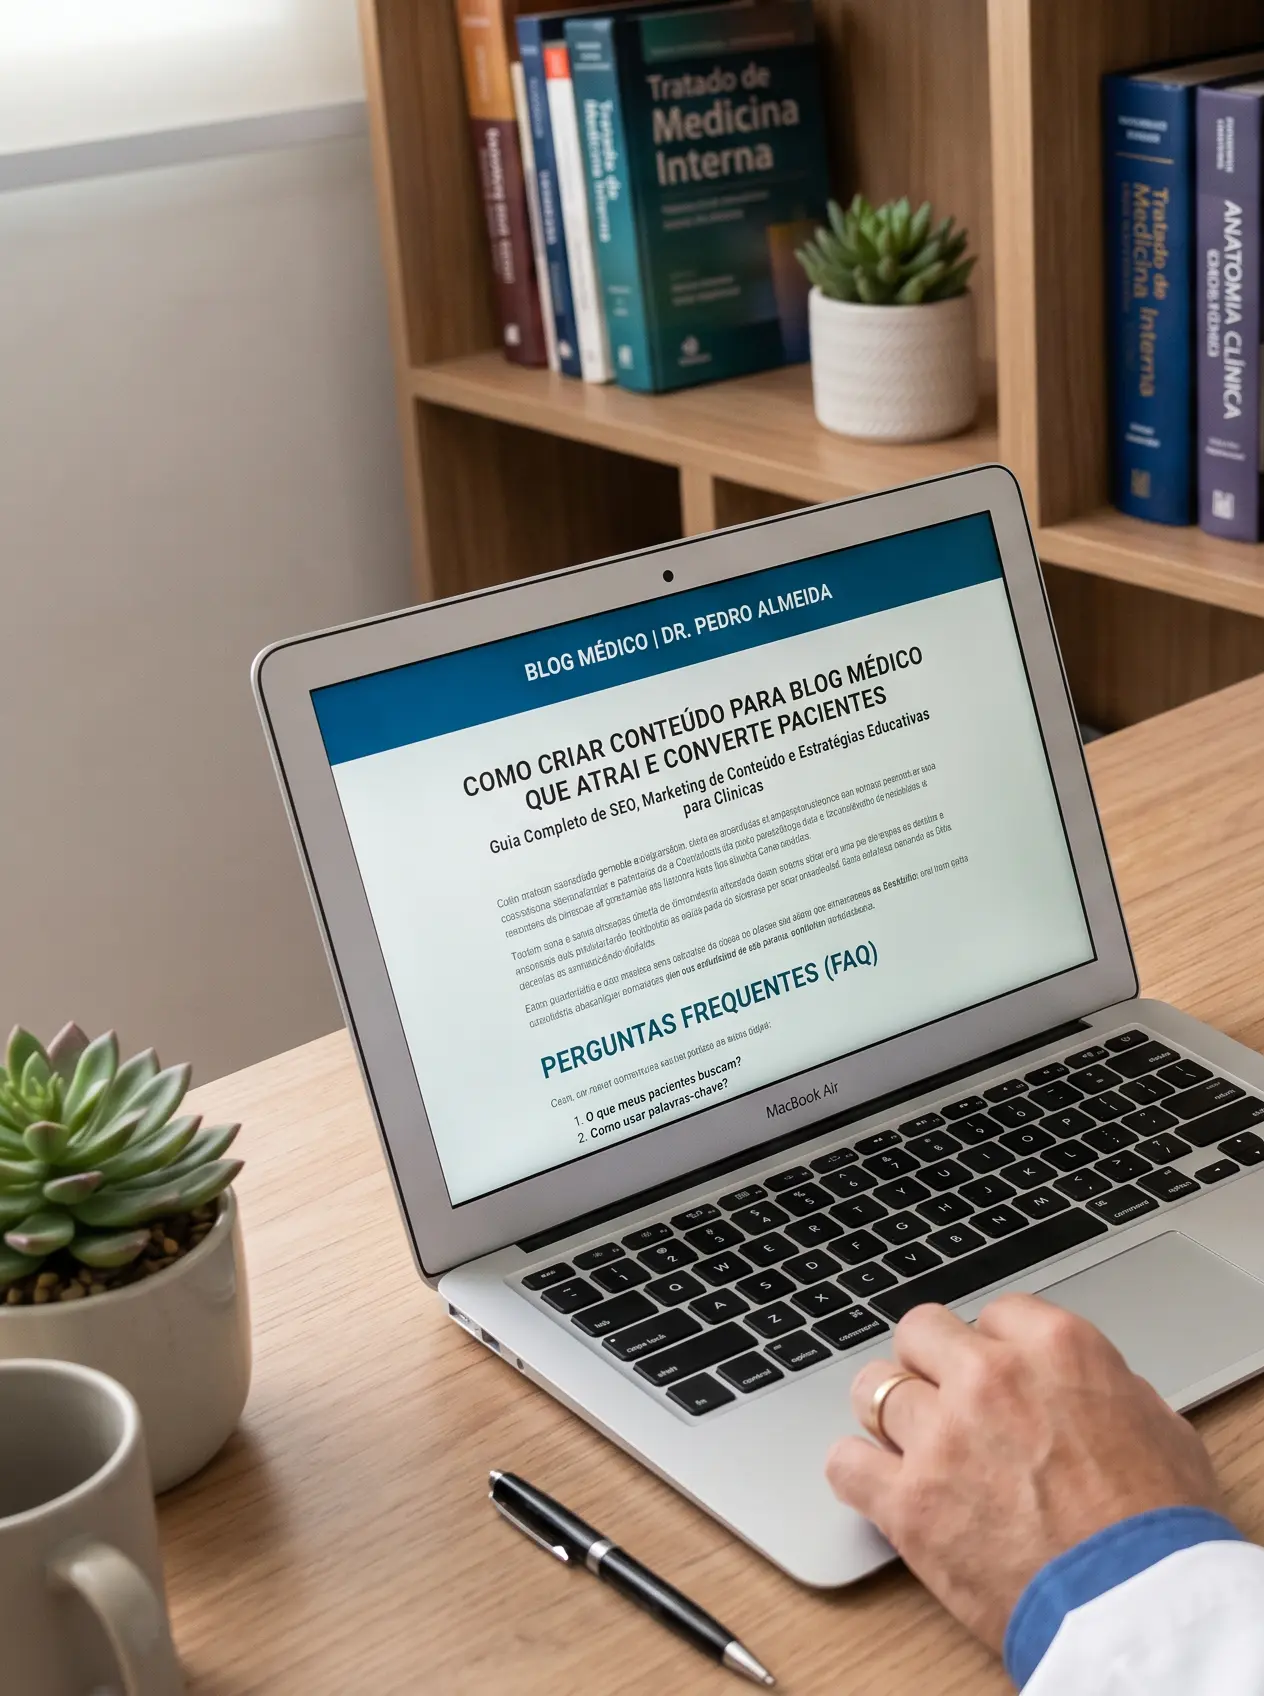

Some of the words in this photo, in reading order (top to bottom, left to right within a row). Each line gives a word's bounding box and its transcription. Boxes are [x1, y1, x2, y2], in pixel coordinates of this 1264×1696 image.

[648, 66, 737, 101] Tratado
[741, 60, 770, 89] de
[651, 96, 799, 144] Medicina
[655, 141, 774, 186] Interna
[1223, 200, 1244, 327] ANATOMIA
[1222, 331, 1244, 421] CLÍNICA
[524, 653, 574, 681] BLOG
[577, 633, 648, 667] MÉDICO
[661, 622, 691, 644] DR.
[694, 605, 752, 635] PEDRO
[758, 583, 833, 618] ALMEIDA
[463, 760, 532, 796] COMO
[538, 739, 606, 774] CRIAR
[610, 704, 725, 753] CONTEÚDO
[729, 686, 787, 719] PARA
[789, 669, 843, 701] BLOG
[846, 646, 922, 684] MÉDICO
[525, 780, 571, 811] QUE
[577, 759, 640, 796] ATRAI
[644, 753, 660, 775] E
[664, 718, 775, 768] CONVERTE
[777, 686, 887, 735] PACIENTES
[490, 835, 521, 854] Guia
[524, 816, 587, 843] Completo
[591, 808, 607, 823] de
[609, 798, 640, 817] SEO,
[641, 779, 706, 807] Marketing
[709, 771, 725, 786] de
[727, 753, 785, 780] Conteúdo
[788, 752, 796, 762] e
[798, 730, 865, 759] Estratégias
[866, 710, 930, 737] Educativas
[683, 798, 712, 819] para
[714, 781, 764, 805] Clinicas
[540, 1013, 677, 1079] PERGUNTAS
[680, 962, 819, 1028] FREQUENTES
[824, 940, 878, 982] (FAQ)
[574, 1116, 584, 1126] 1.
[586, 1111, 594, 1122] O
[596, 1105, 616, 1120] que
[618, 1094, 646, 1111] meus
[648, 1075, 696, 1102] pacientes
[697, 1056, 741, 1081] buscam?
[766, 1088, 821, 1118] MacBook
[823, 1082, 838, 1097] Air
[577, 1132, 588, 1143] 2.
[590, 1121, 621, 1138] Como
[623, 1111, 645, 1126] usar
[648, 1078, 728, 1119] palavras-chave?
[1061, 1118, 1071, 1126] P
[1021, 1135, 1034, 1143] O
[937, 1169, 951, 1177] U
[1022, 1167, 1036, 1176] K
[895, 1187, 906, 1195] Y
[1033, 1197, 1049, 1206] M
[852, 1205, 863, 1213] T
[938, 1203, 953, 1212] H
[991, 1215, 1007, 1224] N
[808, 1224, 821, 1233] R
[895, 1222, 909, 1230] G
[763, 1244, 775, 1252] E
[851, 1241, 860, 1250] F
[904, 1253, 917, 1261] V
[713, 1262, 730, 1272] W
[805, 1261, 819, 1270] D
[861, 1273, 875, 1282] C
[668, 1283, 684, 1292] Q
[759, 1281, 772, 1290] S
[814, 1293, 829, 1303] X
[714, 1301, 727, 1310] A
[767, 1314, 782, 1324] Z
